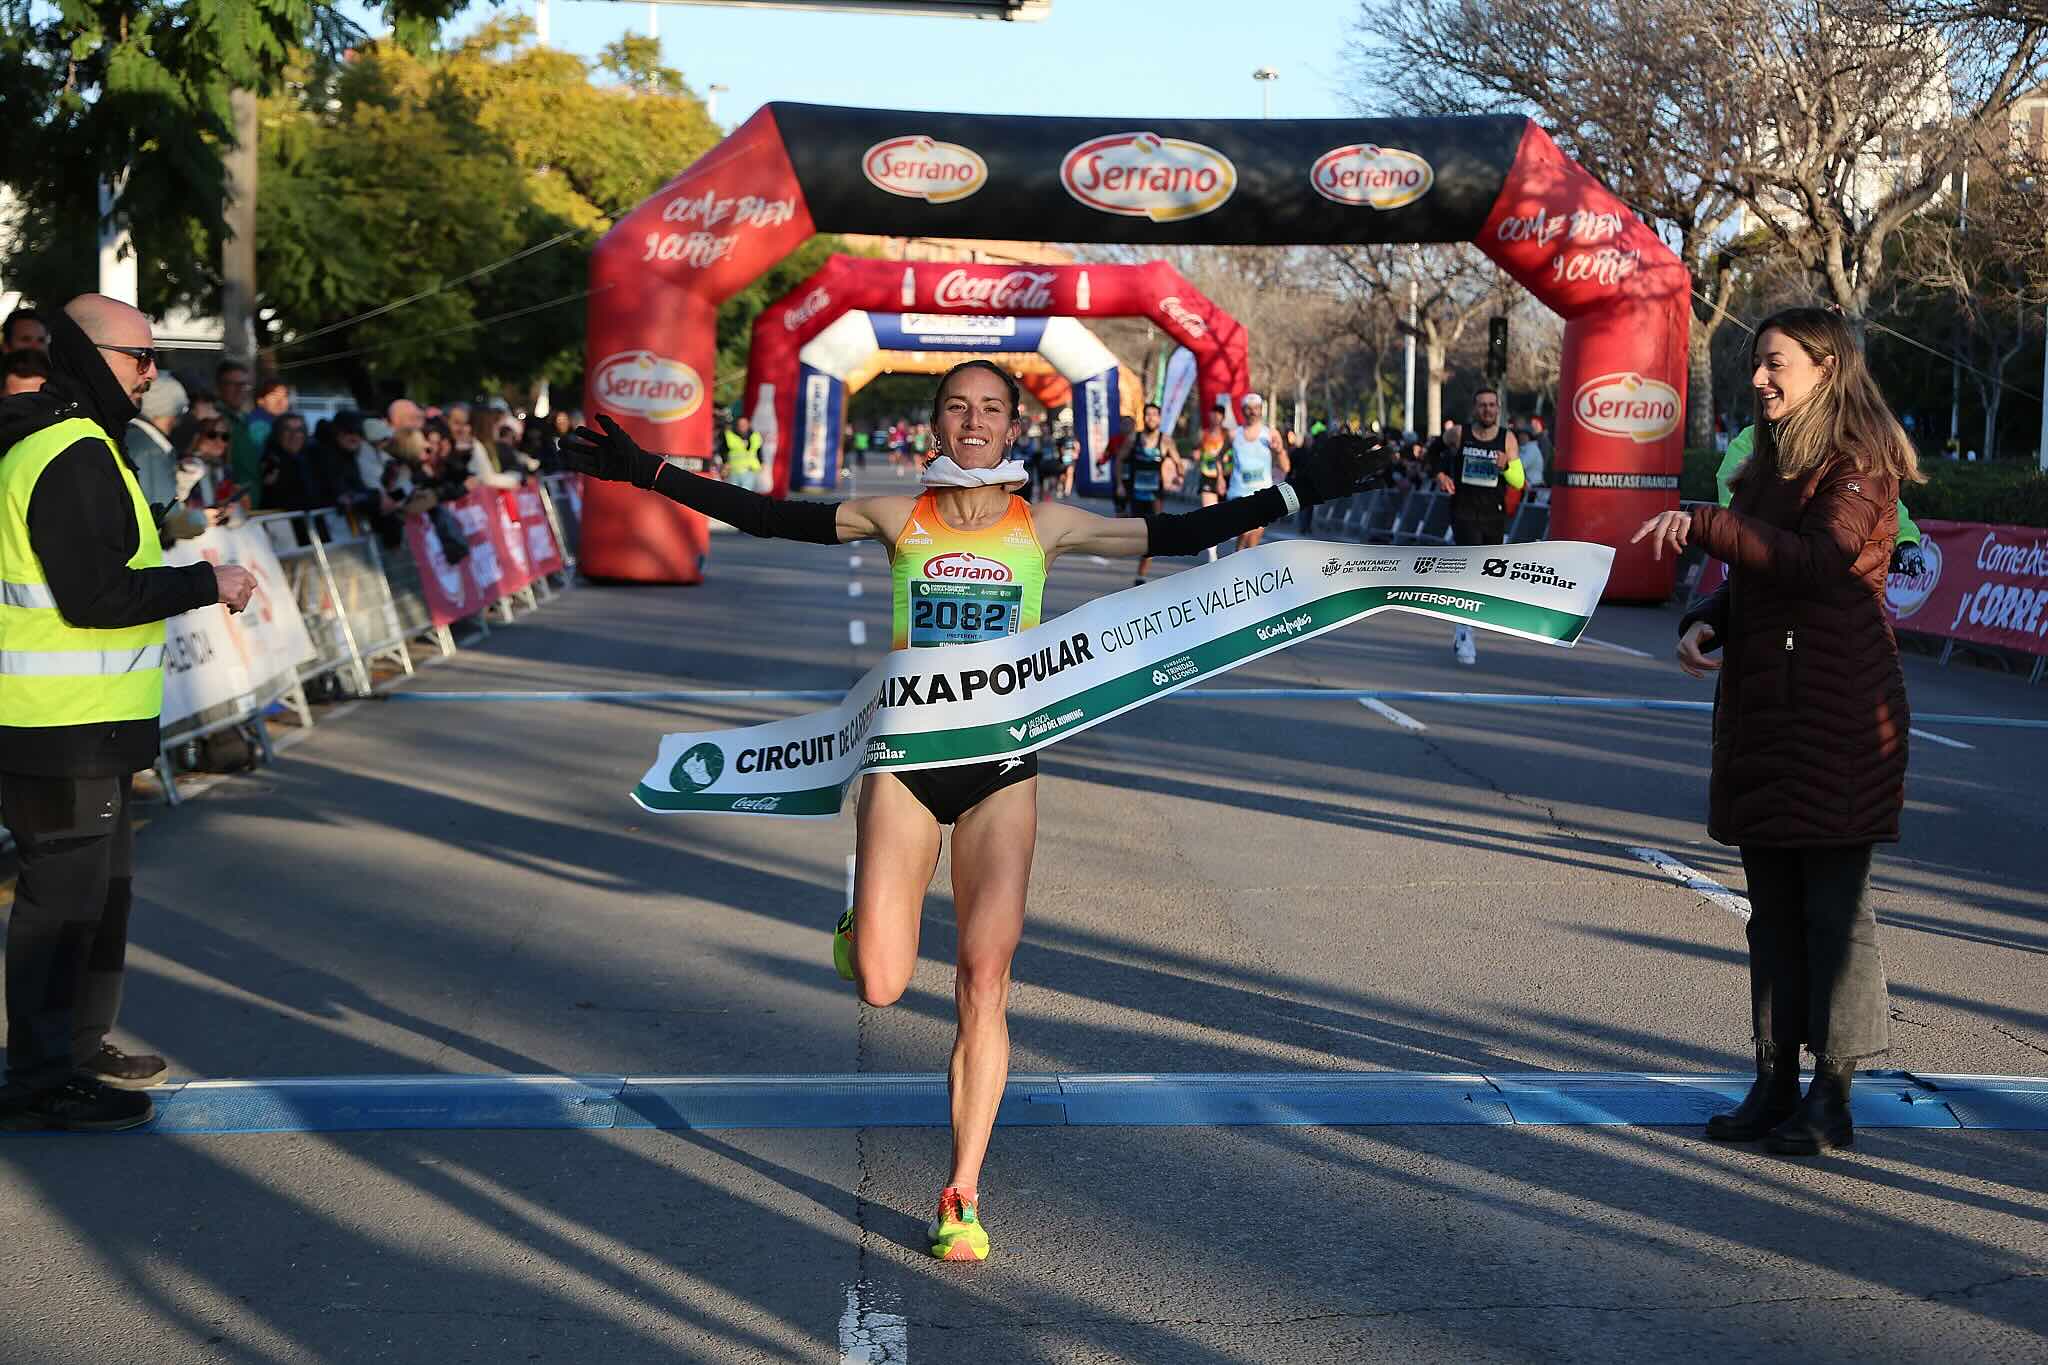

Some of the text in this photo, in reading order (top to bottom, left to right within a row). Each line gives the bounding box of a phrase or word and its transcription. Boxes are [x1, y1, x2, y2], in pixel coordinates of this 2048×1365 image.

[878, 152, 974, 183] Serrano
[1081, 154, 1218, 194] Serrano
[1325, 161, 1421, 189] Serrano
[1498, 206, 1567, 248] COME
[605, 370, 694, 401] Serrano
[1584, 392, 1676, 420] Serrano
[1344, 559, 1402, 567] AJUNTAMENT
[1976, 531, 2029, 574] Come
[930, 560, 1006, 582] Serrano
[1509, 570, 1577, 590] popular
[1512, 561, 1556, 576] caixa
[914, 600, 1006, 632] 2082
[1398, 591, 1485, 613] INTERSPORT
[1256, 612, 1312, 641] El Corte Inglés
[735, 733, 837, 774] CIRCUIT
[839, 725, 850, 758] DE
[878, 673, 957, 709] AIXA
[959, 632, 1095, 701] POPULAR
[1100, 610, 1164, 653] CIUTAT
[1167, 599, 1197, 627] DE
[1196, 566, 1295, 616] VALÈNCIA
[1165, 660, 1195, 676] TRINIDAD
[1170, 666, 1199, 681] ALFONSO
[1047, 718, 1059, 731] DEL
